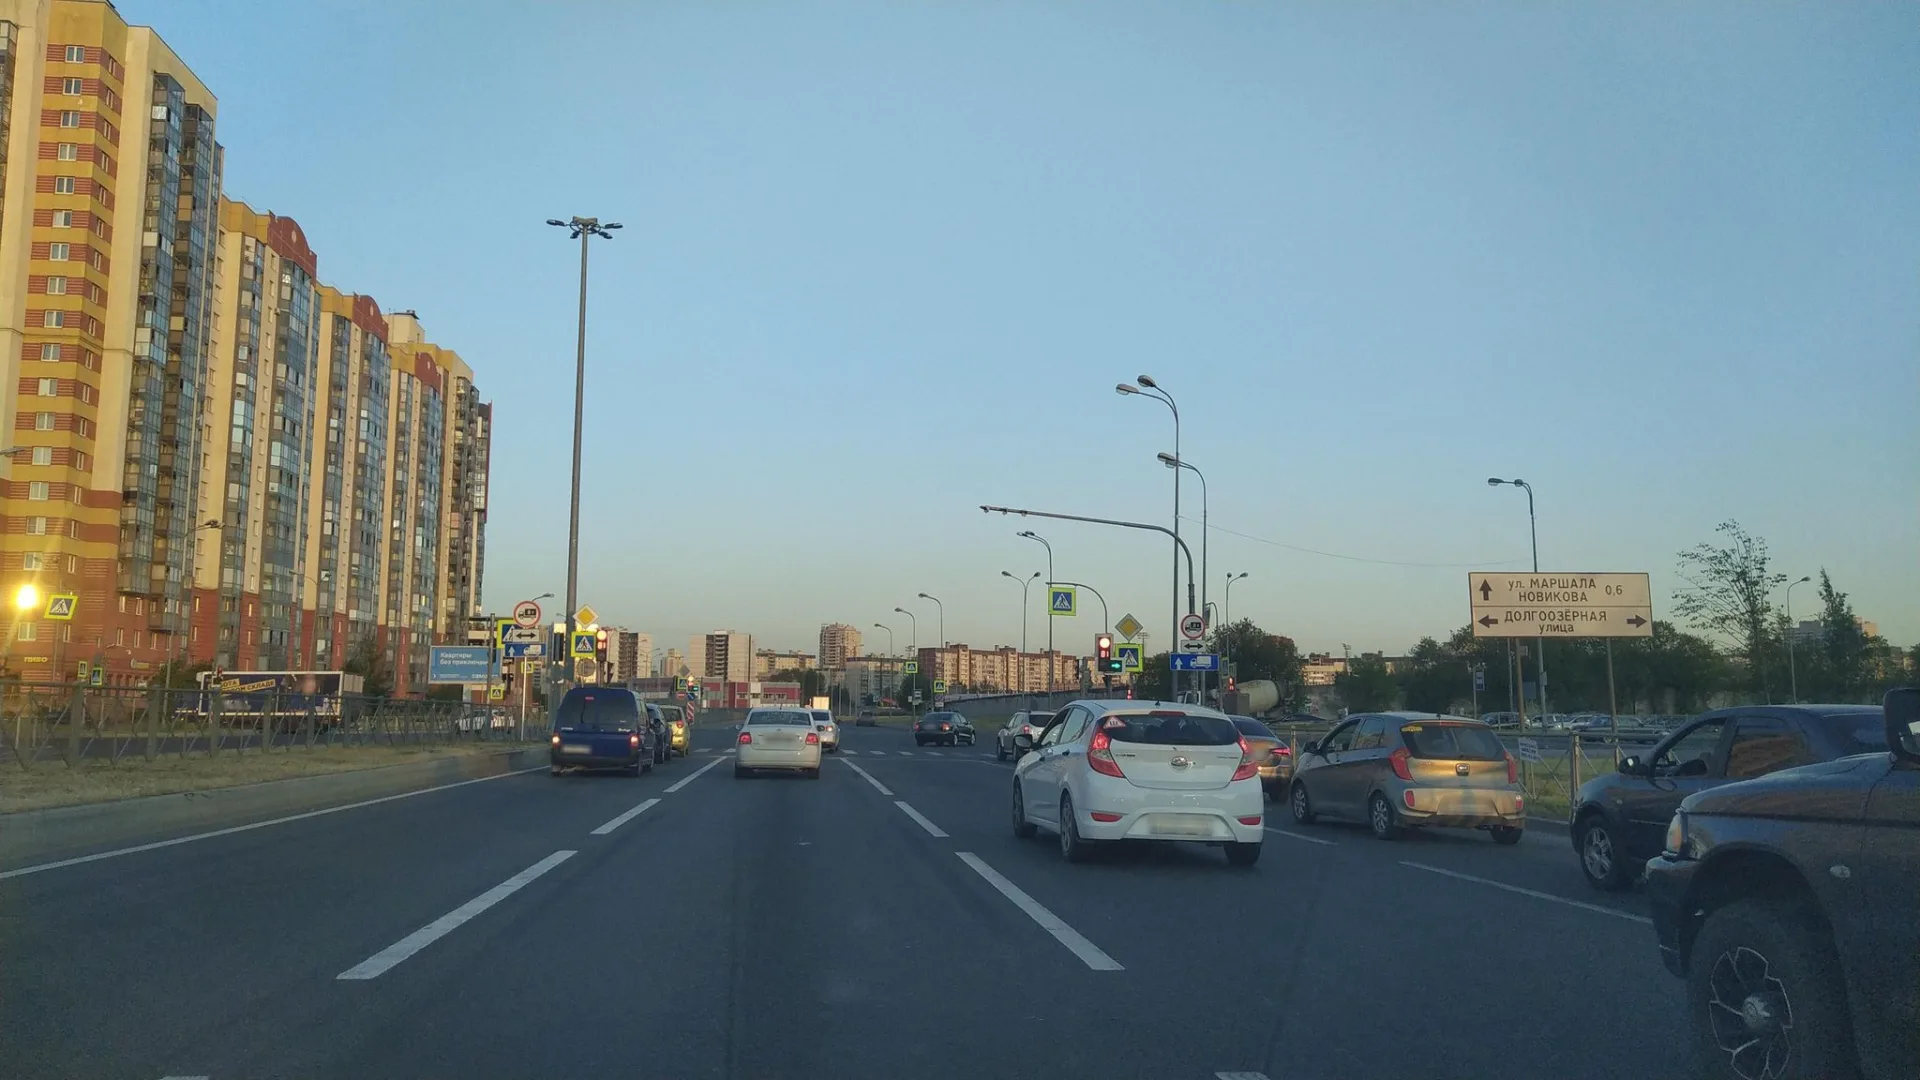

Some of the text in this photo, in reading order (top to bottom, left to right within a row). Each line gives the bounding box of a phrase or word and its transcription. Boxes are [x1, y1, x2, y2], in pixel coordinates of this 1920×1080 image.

[1508, 578, 1597, 591] ул. МАРШАЛА
[1605, 584, 1623, 596] 0,6
[1518, 591, 1588, 602] НОВИКОВА
[1504, 608, 1607, 623] ДОЛГООЗЁРНАЯ
[1539, 623, 1574, 635] улица
